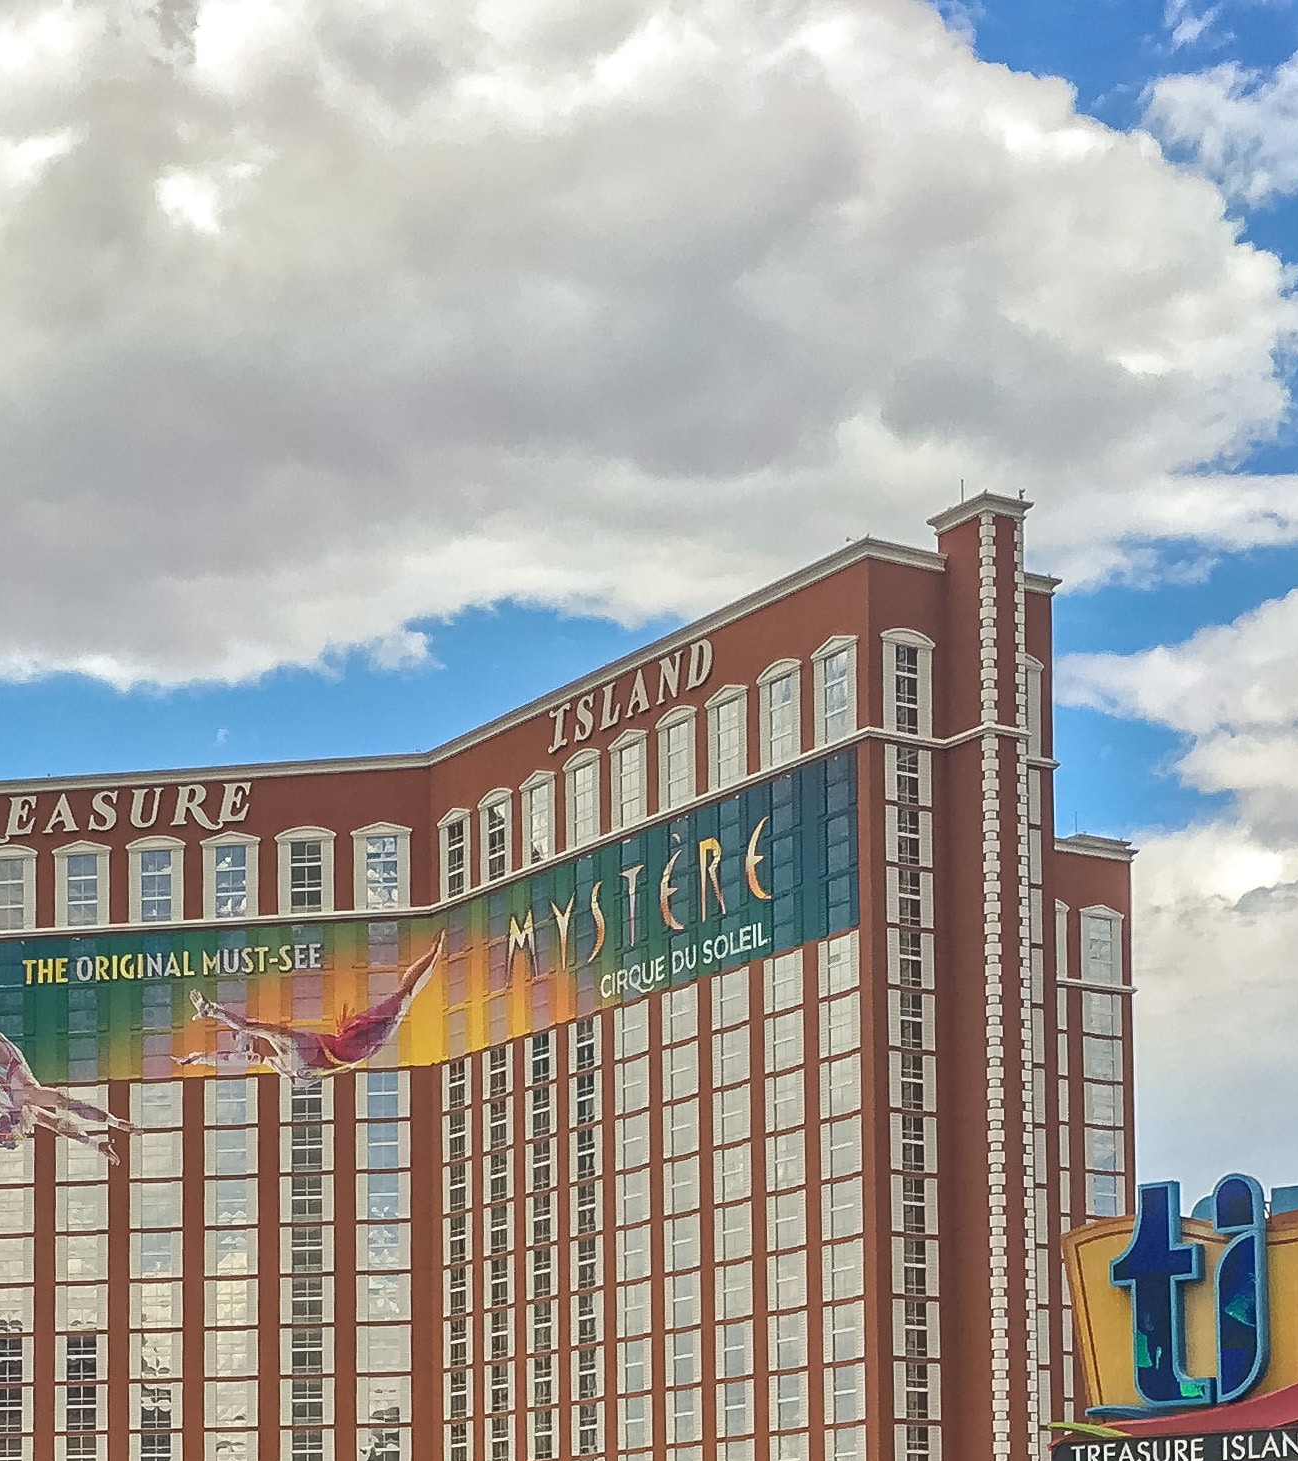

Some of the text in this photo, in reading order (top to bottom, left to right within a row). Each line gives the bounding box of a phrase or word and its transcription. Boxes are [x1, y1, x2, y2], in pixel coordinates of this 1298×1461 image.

[548, 638, 714, 755] ISLAND
[505, 815, 773, 988] MYSTÈRE
[23, 943, 323, 986] THE ORIGINAL MUST-SEE
[601, 922, 771, 999] CIRQUE DU SOLEIL
